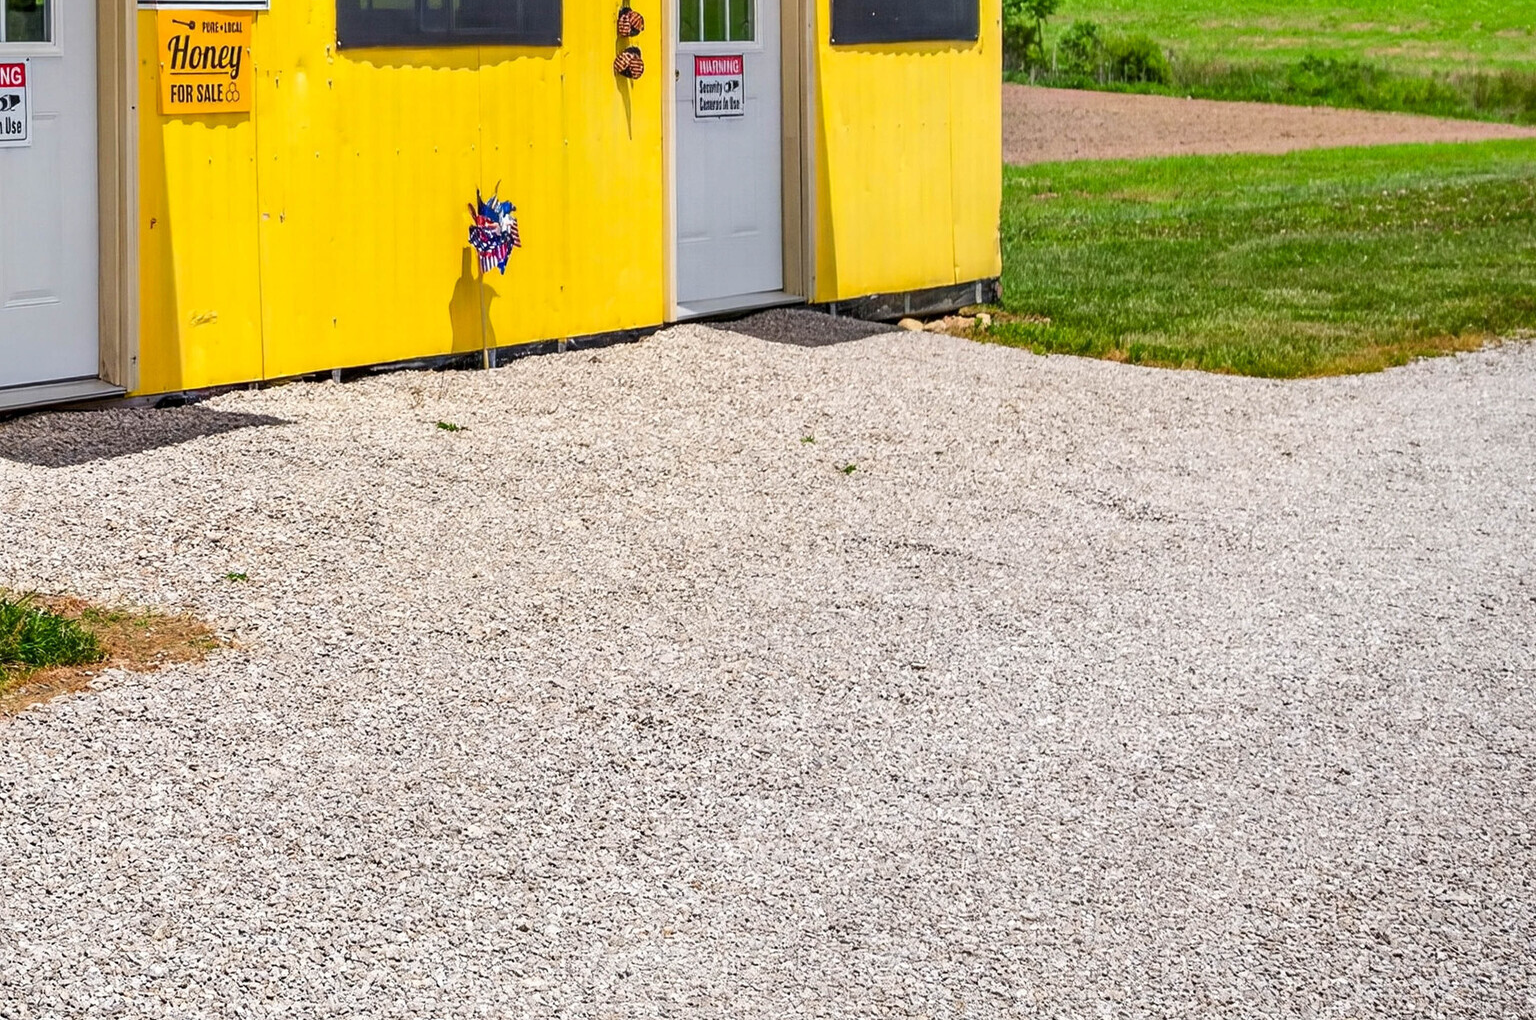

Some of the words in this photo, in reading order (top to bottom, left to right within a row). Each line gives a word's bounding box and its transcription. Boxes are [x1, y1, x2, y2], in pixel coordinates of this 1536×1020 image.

[167, 35, 242, 80] Honey
[699, 59, 739, 74] WARNING
[170, 84, 193, 103] FOR
[196, 84, 223, 103] SALE
[5, 116, 22, 135] Use
